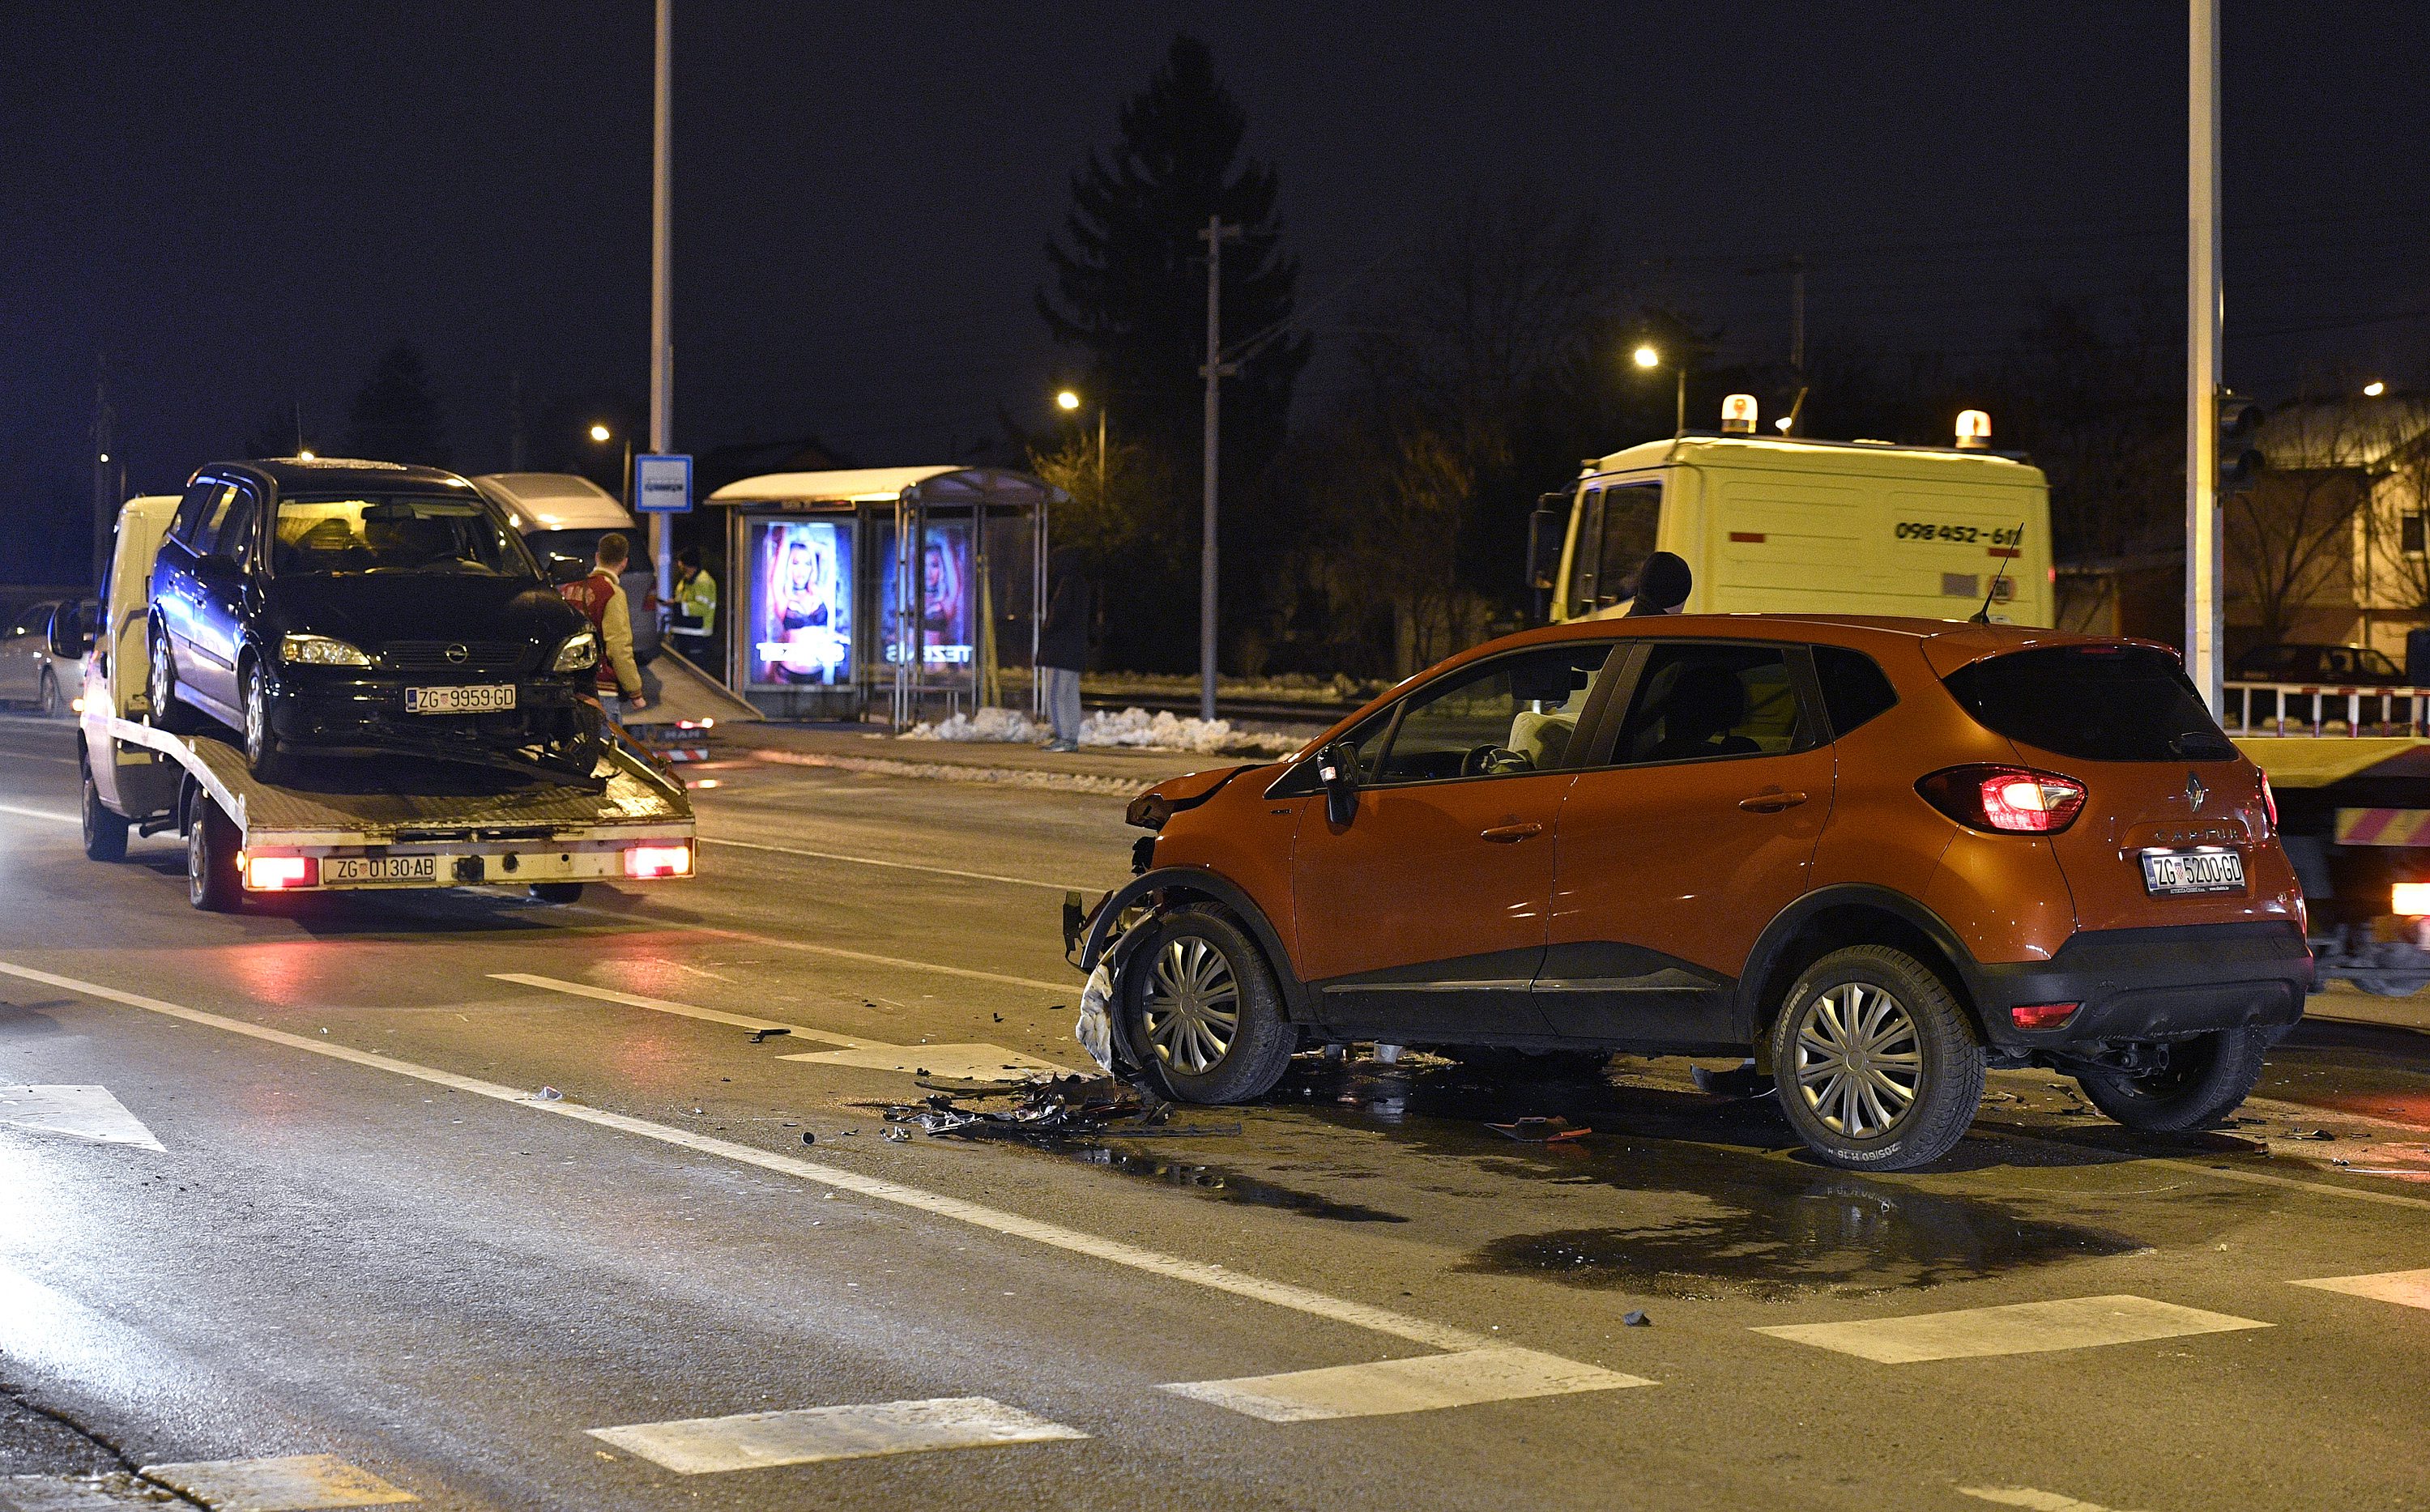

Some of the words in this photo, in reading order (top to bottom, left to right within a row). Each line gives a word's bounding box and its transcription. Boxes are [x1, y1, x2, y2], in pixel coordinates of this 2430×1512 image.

[419, 691, 438, 708] ZG
[338, 861, 357, 878] ZG
[2154, 858, 2176, 885] ZG
